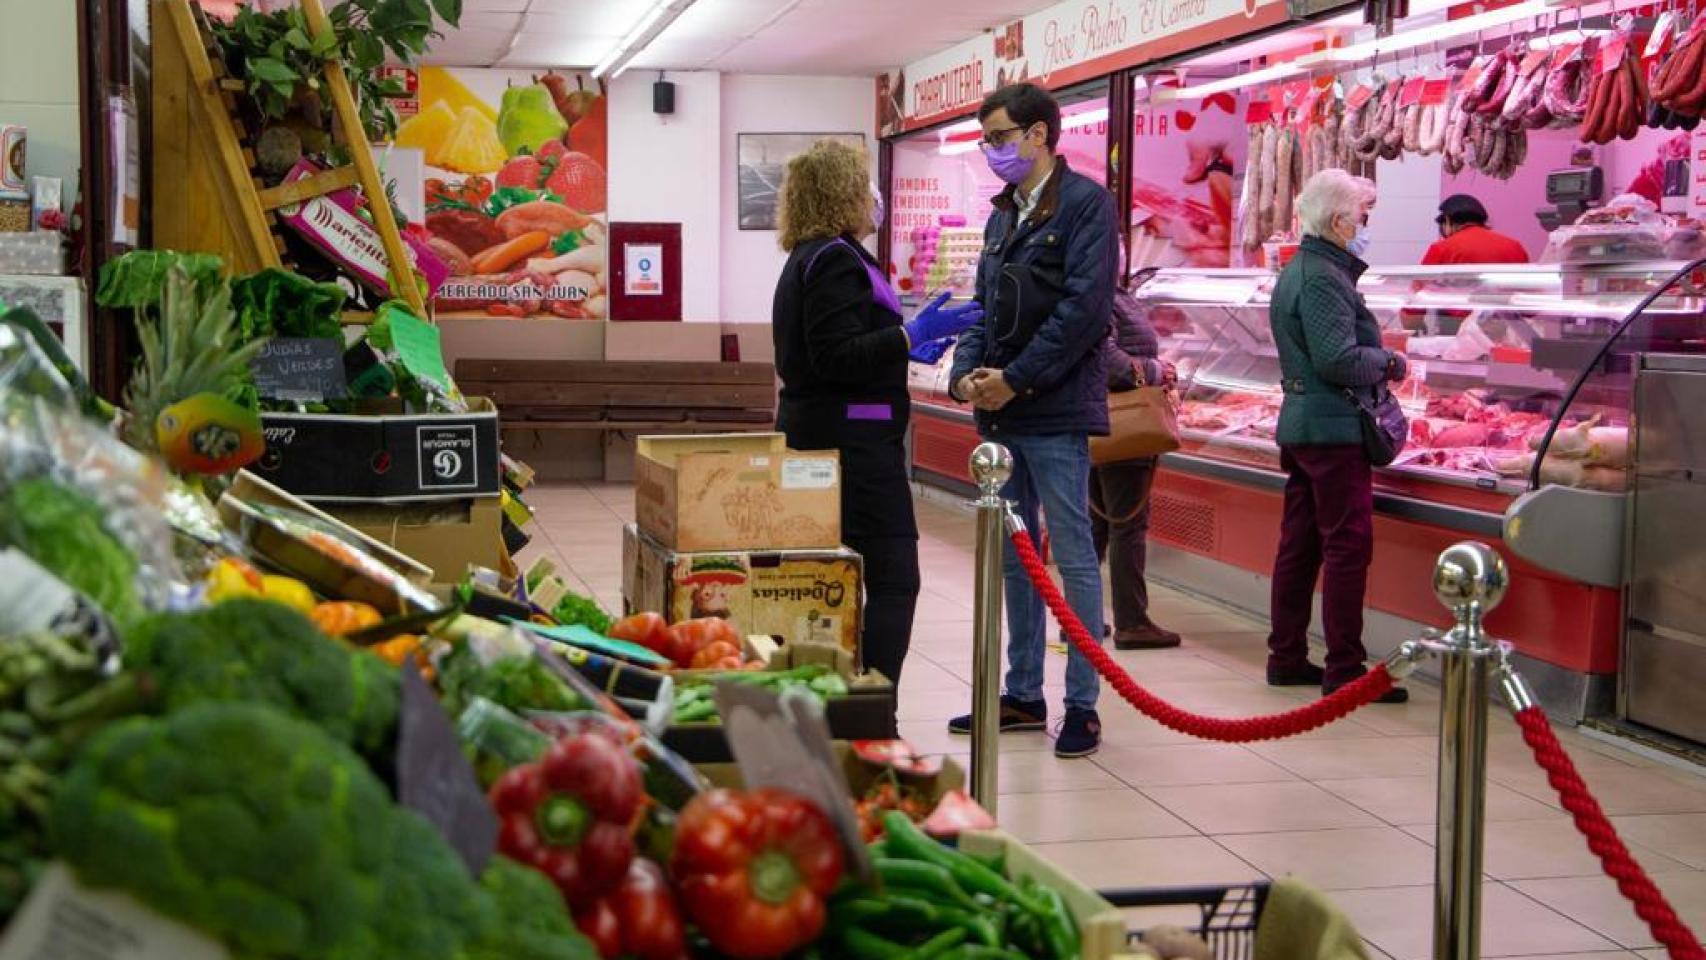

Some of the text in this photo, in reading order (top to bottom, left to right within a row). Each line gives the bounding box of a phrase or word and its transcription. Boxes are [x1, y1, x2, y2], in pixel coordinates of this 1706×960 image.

[913, 52, 984, 117] CHARCUTERÍA
[895, 177, 939, 191] JAMONES
[894, 195, 950, 209] EMBUTIDOS
[894, 212, 933, 226] QUESOS
[513, 285, 543, 299] SAN
[549, 284, 589, 299] JUAN
